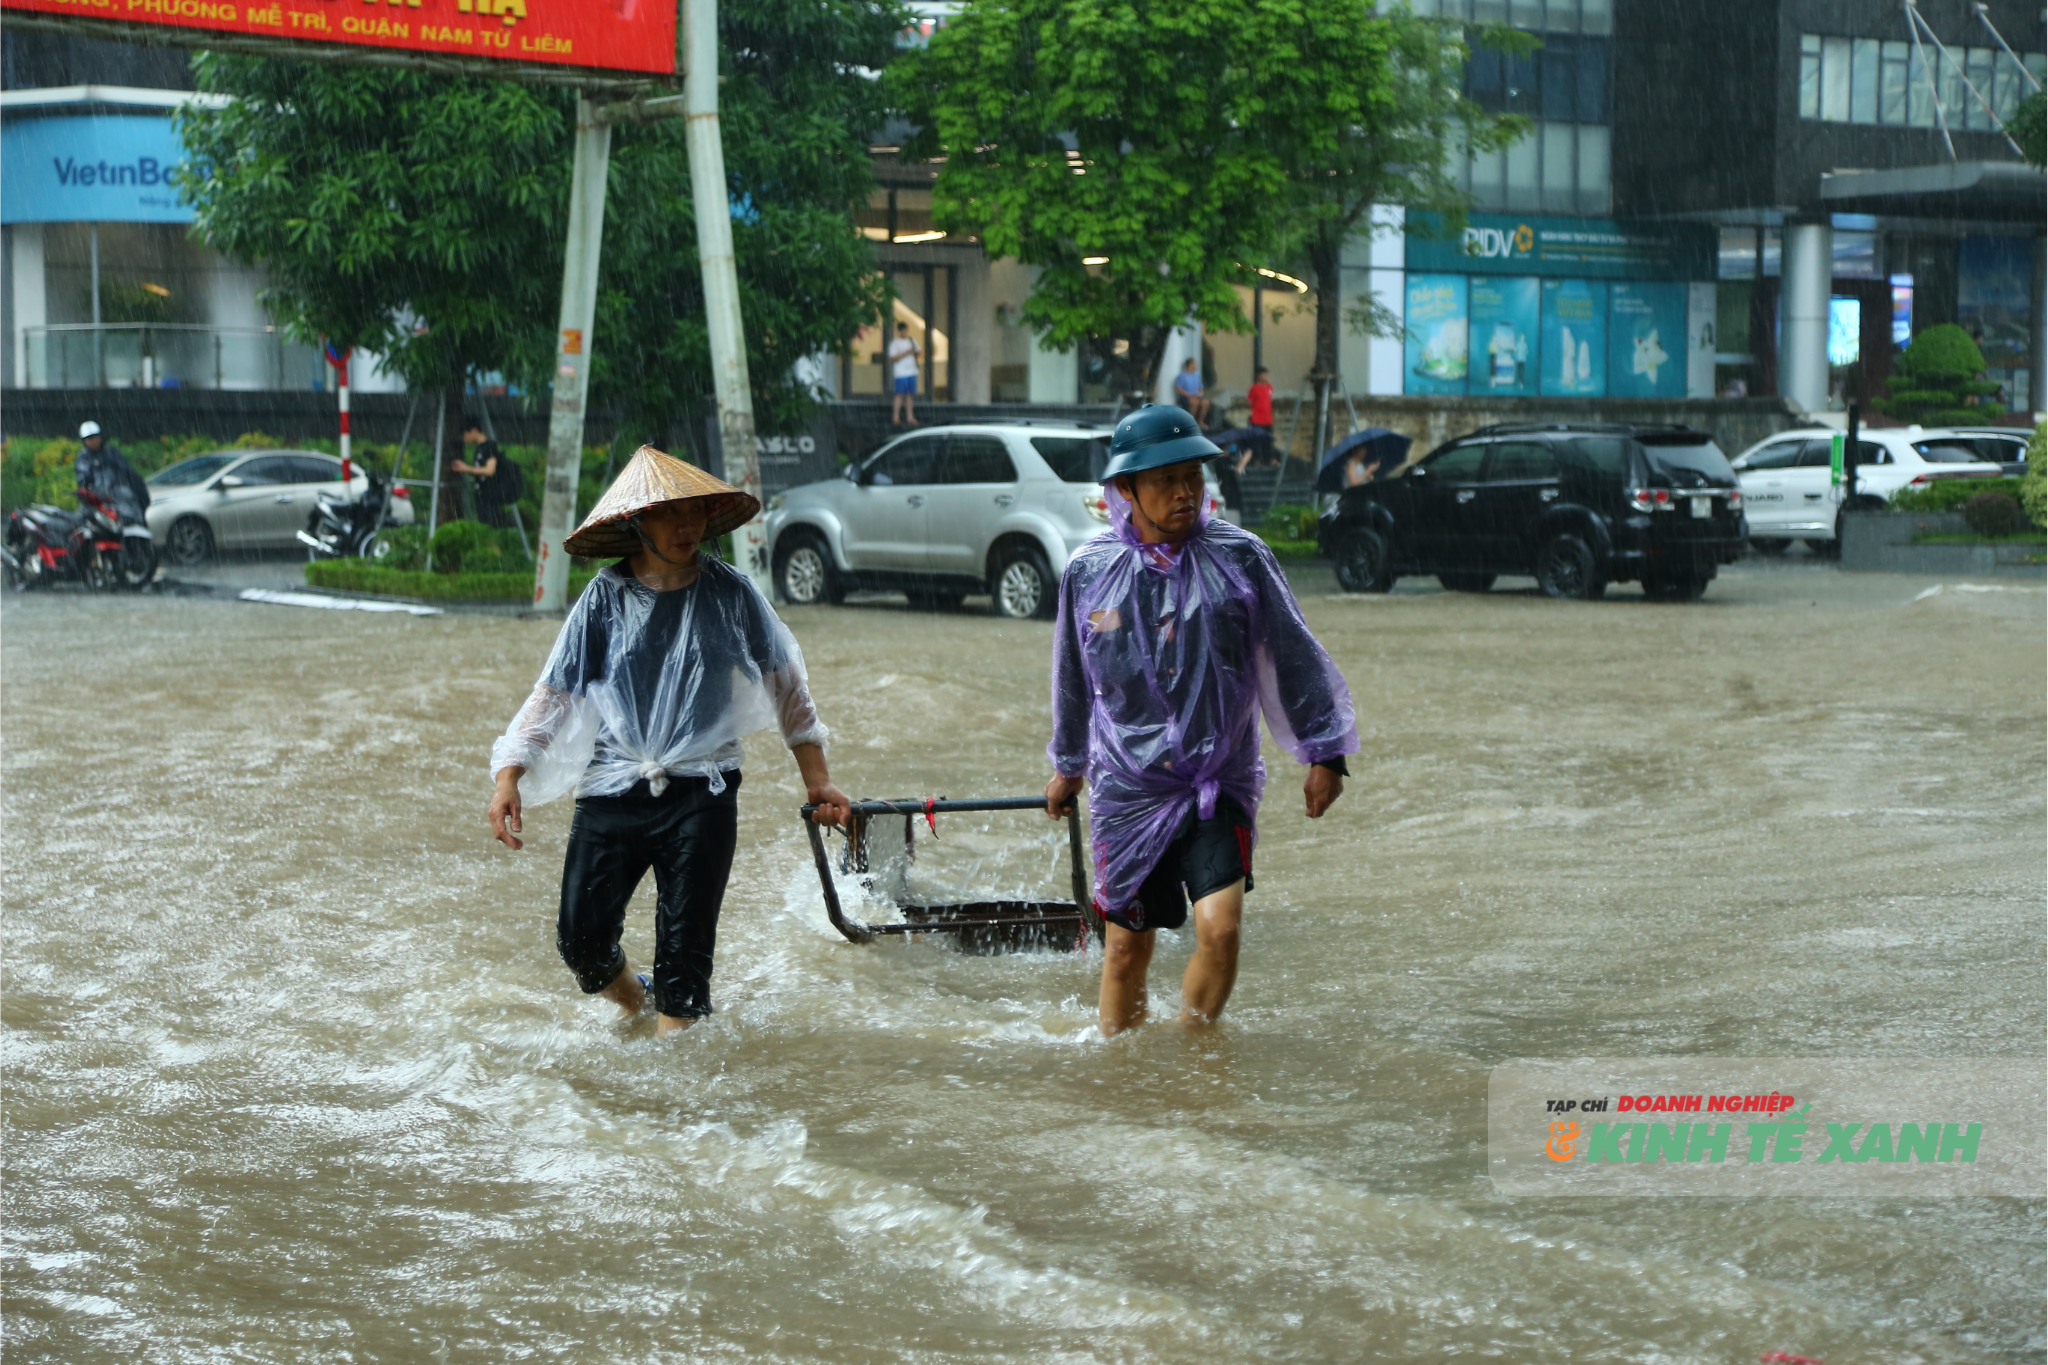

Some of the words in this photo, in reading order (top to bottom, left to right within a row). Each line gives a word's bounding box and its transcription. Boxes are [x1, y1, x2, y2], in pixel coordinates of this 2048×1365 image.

[342, 16, 409, 40] QUẬN
[420, 24, 473, 44] NAM
[521, 33, 573, 53] LIÊM
[54, 156, 214, 187] VietinBa
